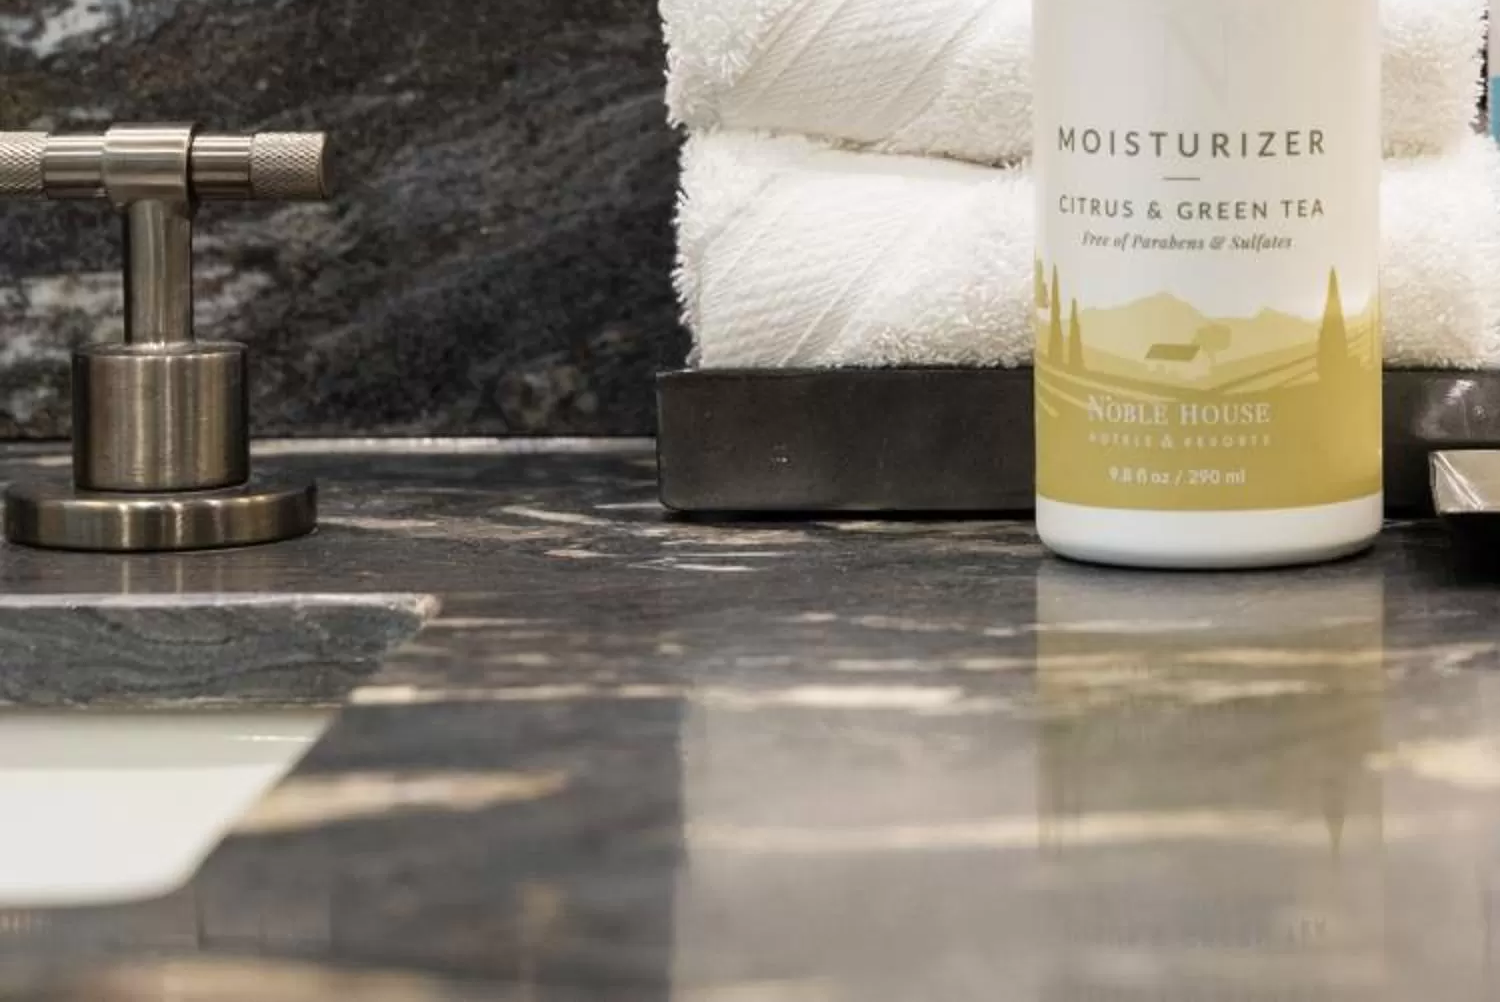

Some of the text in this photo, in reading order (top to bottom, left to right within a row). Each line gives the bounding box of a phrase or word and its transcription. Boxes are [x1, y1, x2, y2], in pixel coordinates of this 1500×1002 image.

[1058, 127, 1325, 158] MOISTURIZER
[1059, 194, 1324, 221] CITRUS & GREEN TEA
[1113, 232, 1130, 251] of
[1132, 233, 1204, 250] Parabens
[1231, 233, 1293, 252] Sulfates
[1087, 394, 1272, 425] NOBLE HOUSE
[1225, 469, 1246, 484] ml
